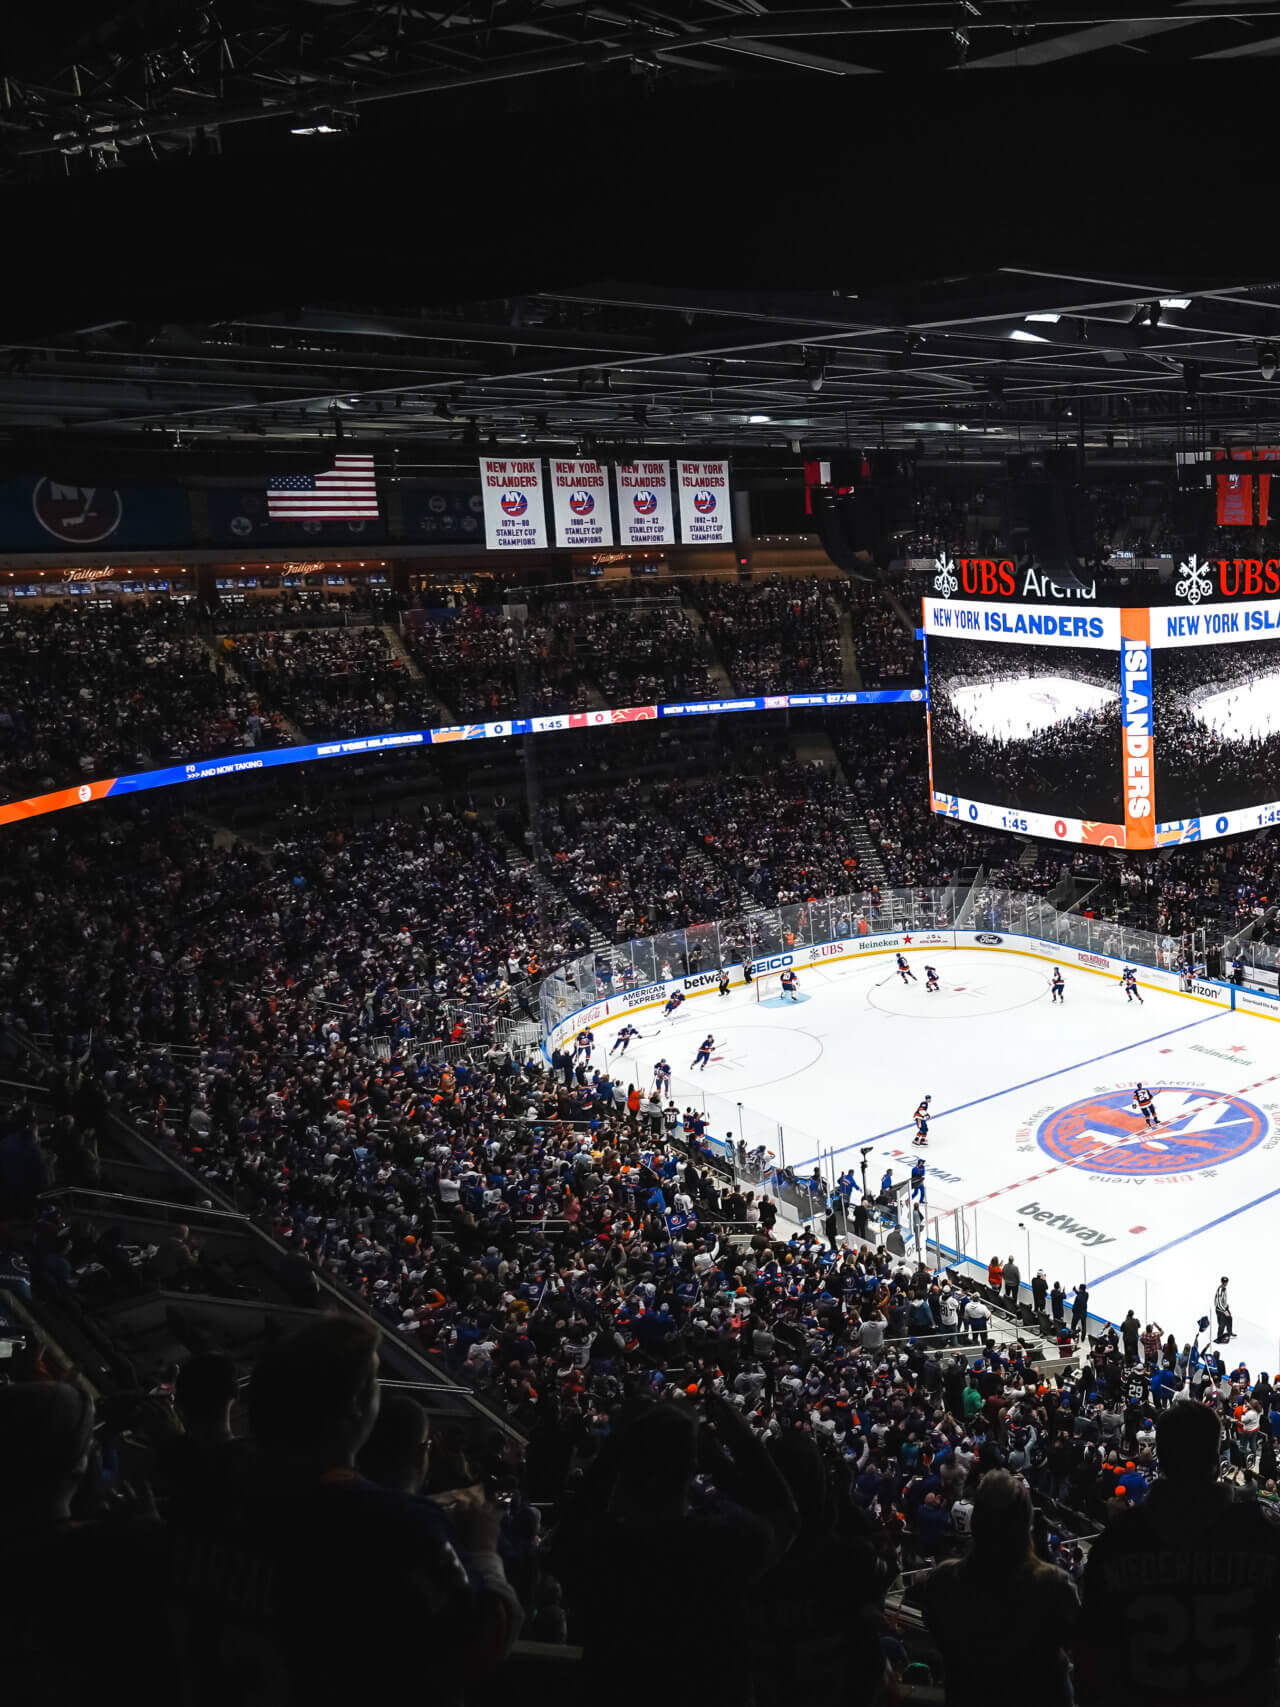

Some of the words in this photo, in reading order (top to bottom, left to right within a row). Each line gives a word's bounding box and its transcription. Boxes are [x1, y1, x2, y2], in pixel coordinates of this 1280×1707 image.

[486, 462, 507, 473] NEW
[511, 462, 535, 473] YORK
[556, 463, 575, 473] NEW
[643, 464, 664, 474] YORK
[683, 464, 699, 474] NEW
[703, 464, 723, 474] YORK
[487, 476, 537, 487] ISLANDERS
[556, 477, 604, 487] ISLANDERS
[621, 477, 666, 487] ISLANDERS
[682, 477, 725, 487] ISLANDERS
[567, 536, 602, 544] CHAMPIONS
[692, 533, 722, 541] CHAMPIONS
[960, 559, 1015, 596] UBS
[1218, 559, 1280, 596] UBS
[933, 608, 951, 627] NEW
[955, 610, 981, 630] YORK
[985, 611, 1104, 639] ISLANDERS
[1167, 616, 1200, 637] NEW
[1204, 613, 1240, 635] YORK
[494, 723, 504, 734] 0
[539, 719, 563, 731] 1:45
[594, 712, 604, 723] 0
[1125, 640, 1151, 819] ISLANDERS
[200, 768, 216, 777] AND
[217, 765, 234, 775] NOW
[235, 760, 263, 771] TAKING
[969, 804, 978, 821] 0
[1001, 816, 1028, 832] 1:45
[1054, 819, 1067, 838] 0
[1216, 816, 1229, 834] 0
[859, 938, 899, 950] Heineken
[979, 933, 998, 944] Ford
[822, 943, 844, 957] UBS
[622, 985, 665, 1002] AMERICAN
[629, 991, 666, 1007] EXPRESS
[1016, 1201, 1117, 1247] betway
[1129, 1384, 1143, 1398] 29
